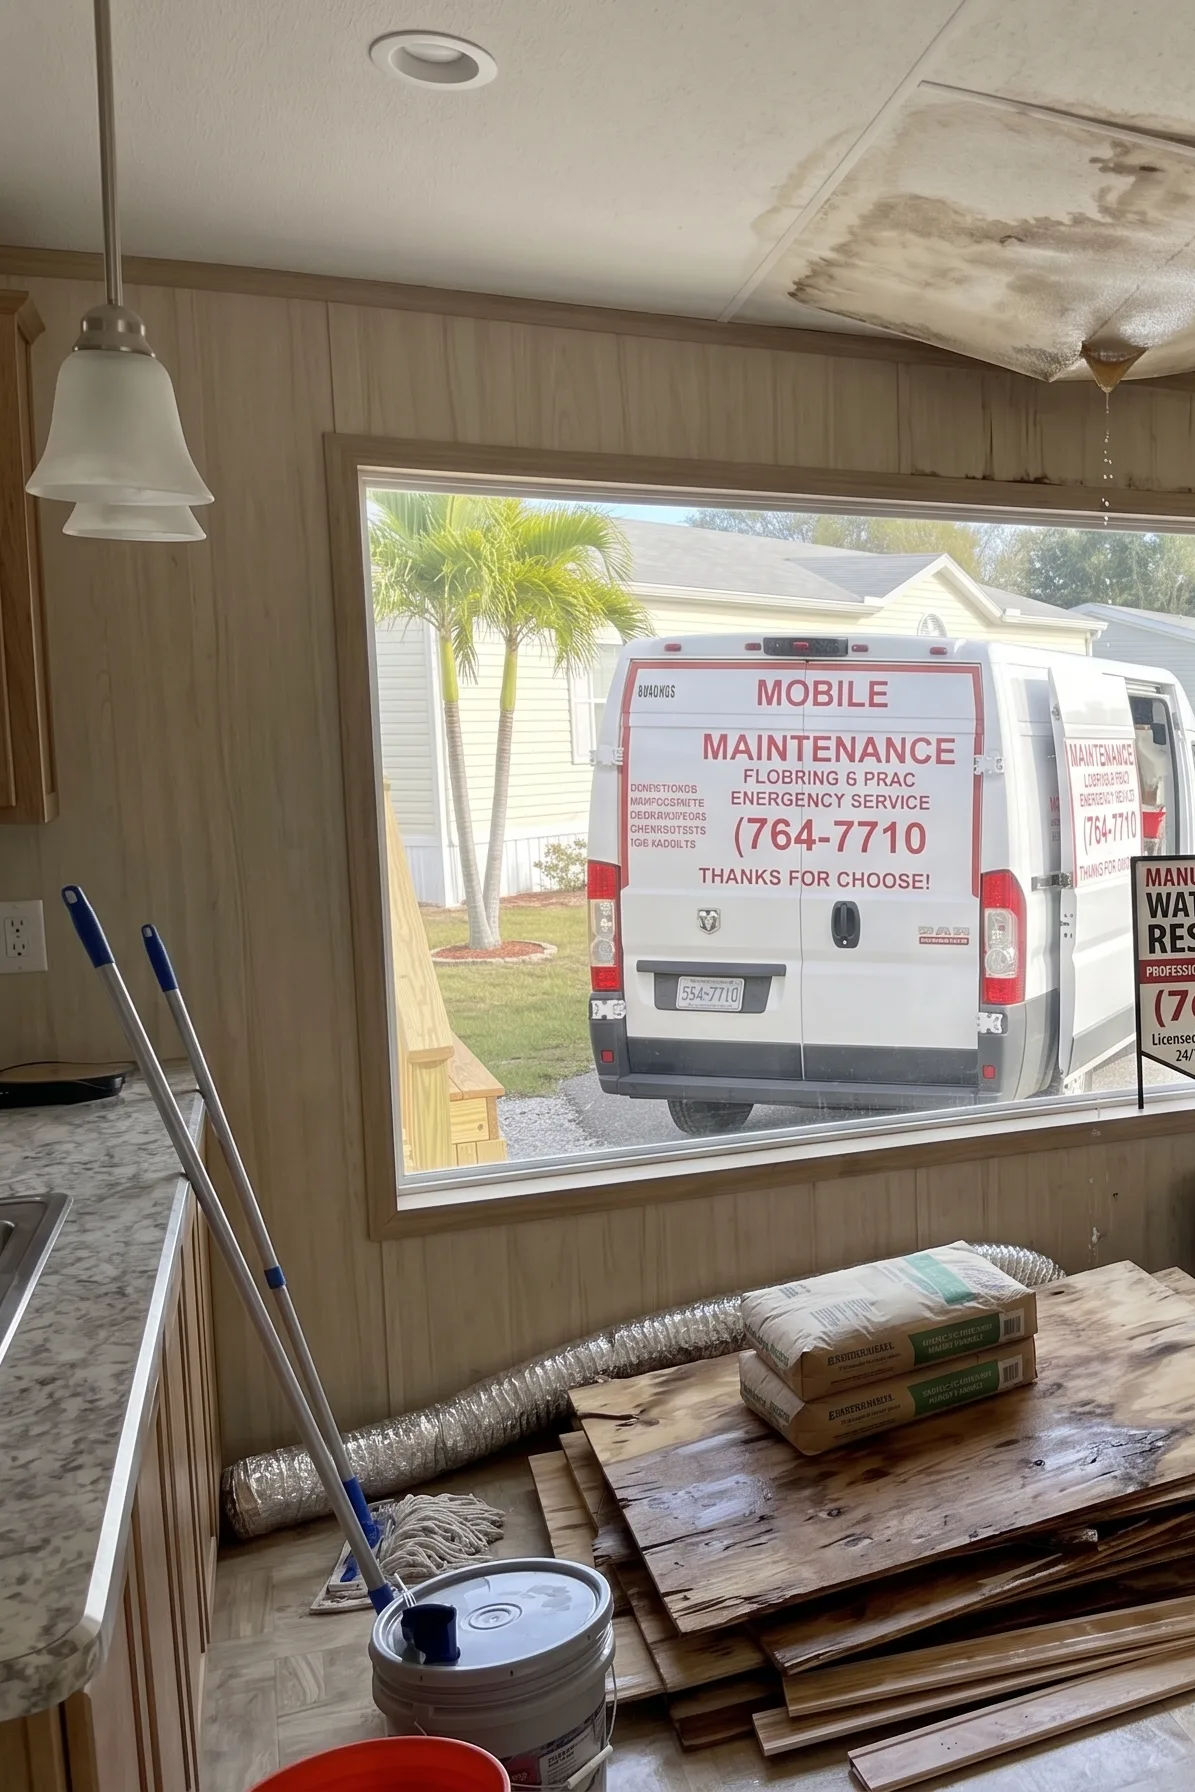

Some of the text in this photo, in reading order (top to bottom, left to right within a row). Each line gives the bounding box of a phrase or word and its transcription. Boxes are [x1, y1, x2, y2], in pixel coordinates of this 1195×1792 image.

[757, 679, 888, 708] MOBILE
[703, 733, 955, 765] MAINTENANCE
[1069, 744, 1134, 767] MAINTENANCE
[743, 769, 839, 786] FLOBRING
[864, 772, 916, 787] PRAC
[731, 791, 930, 810] ENERGENCY SERVICE
[734, 817, 926, 858] (764-7710
[1084, 811, 1137, 856] (764-7710
[699, 868, 930, 890] THANKS FOR CHOOSE!
